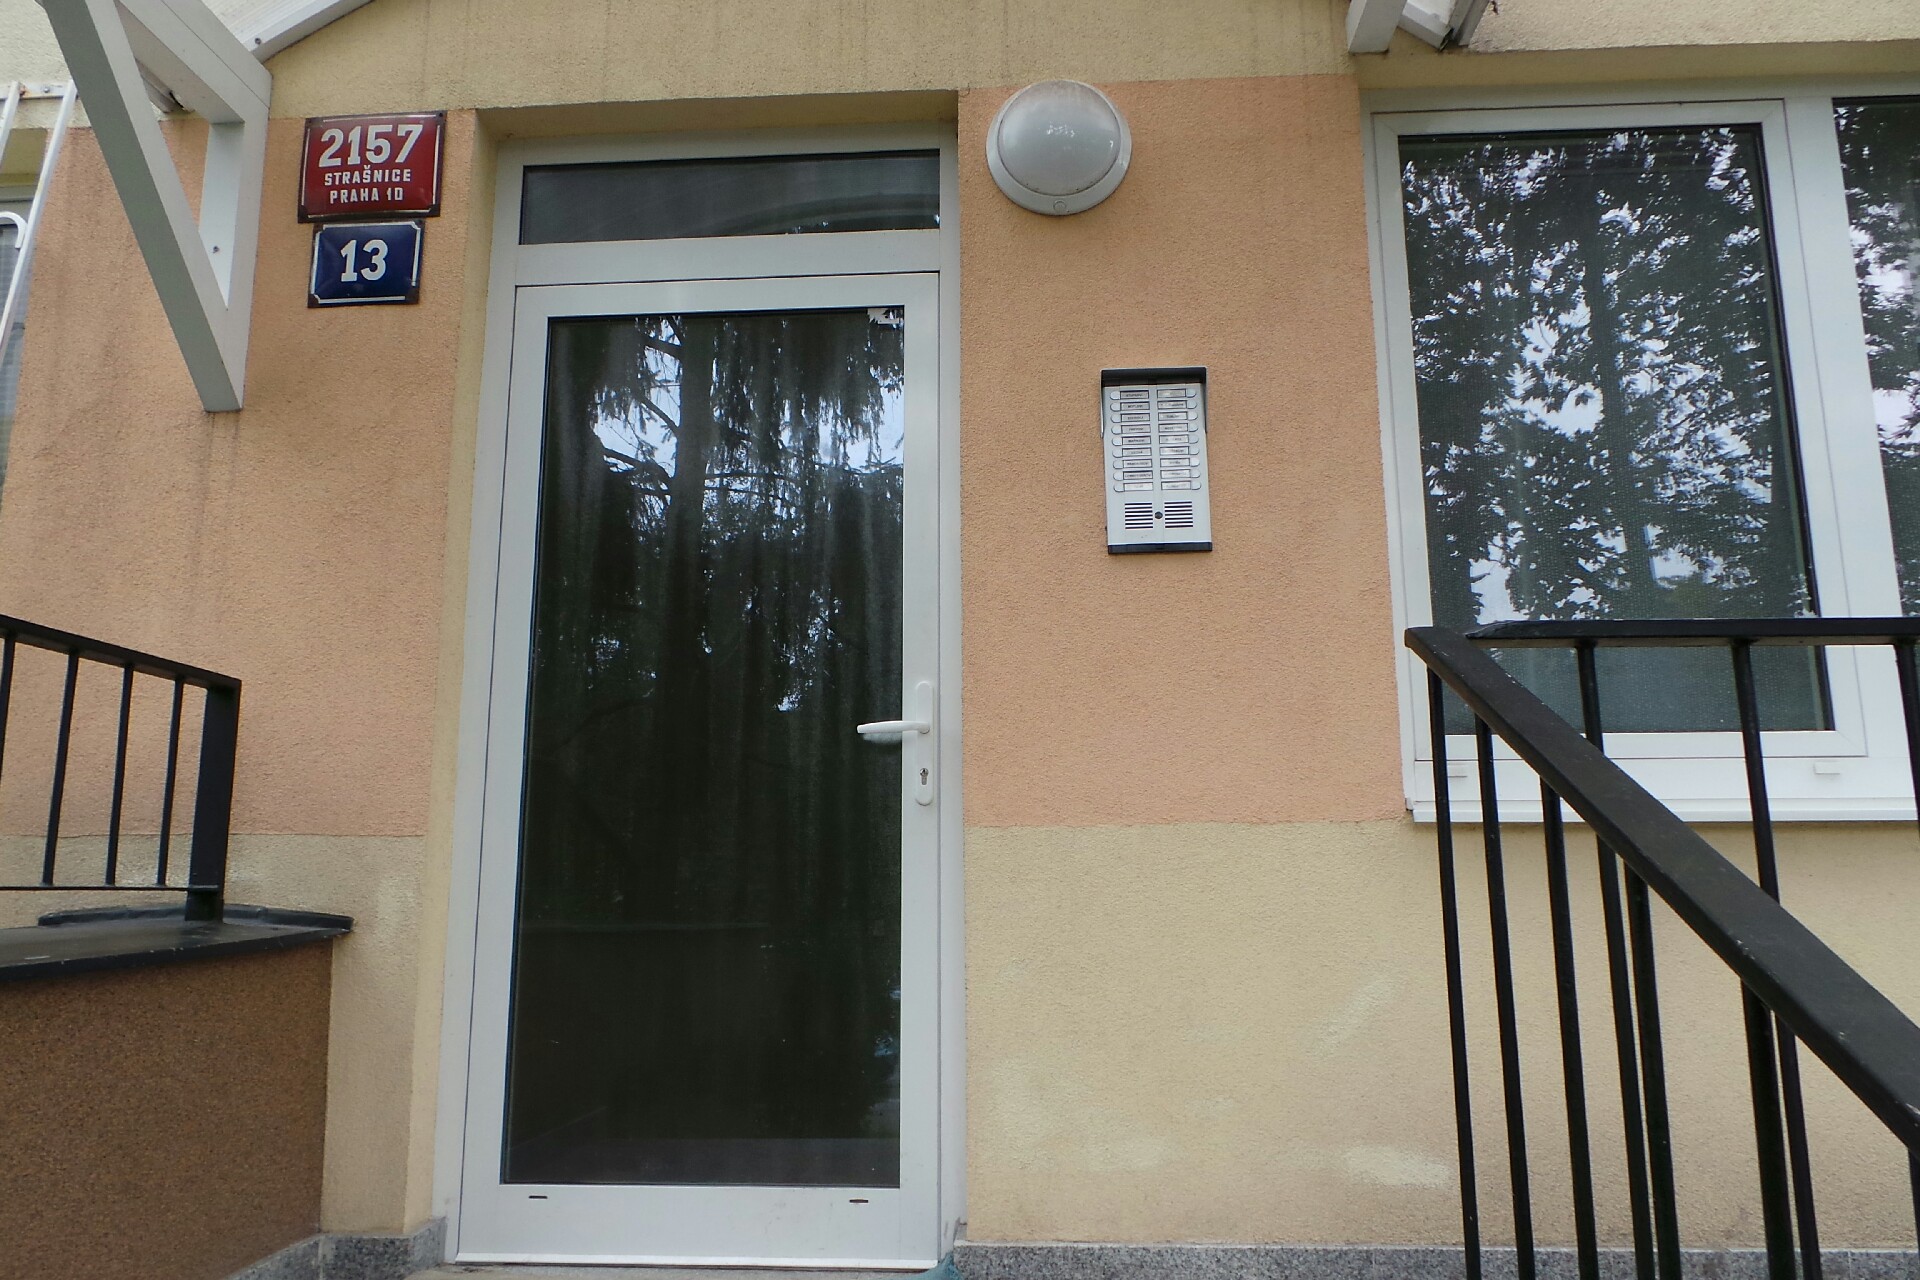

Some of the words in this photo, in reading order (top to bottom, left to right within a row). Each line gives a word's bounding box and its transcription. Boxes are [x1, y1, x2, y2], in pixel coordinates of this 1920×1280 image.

[319, 124, 424, 167] 2157
[324, 165, 411, 186] STRAŠNICE
[330, 188, 379, 204] PRAHA
[386, 187, 404, 201] 10
[340, 239, 389, 282] 13
